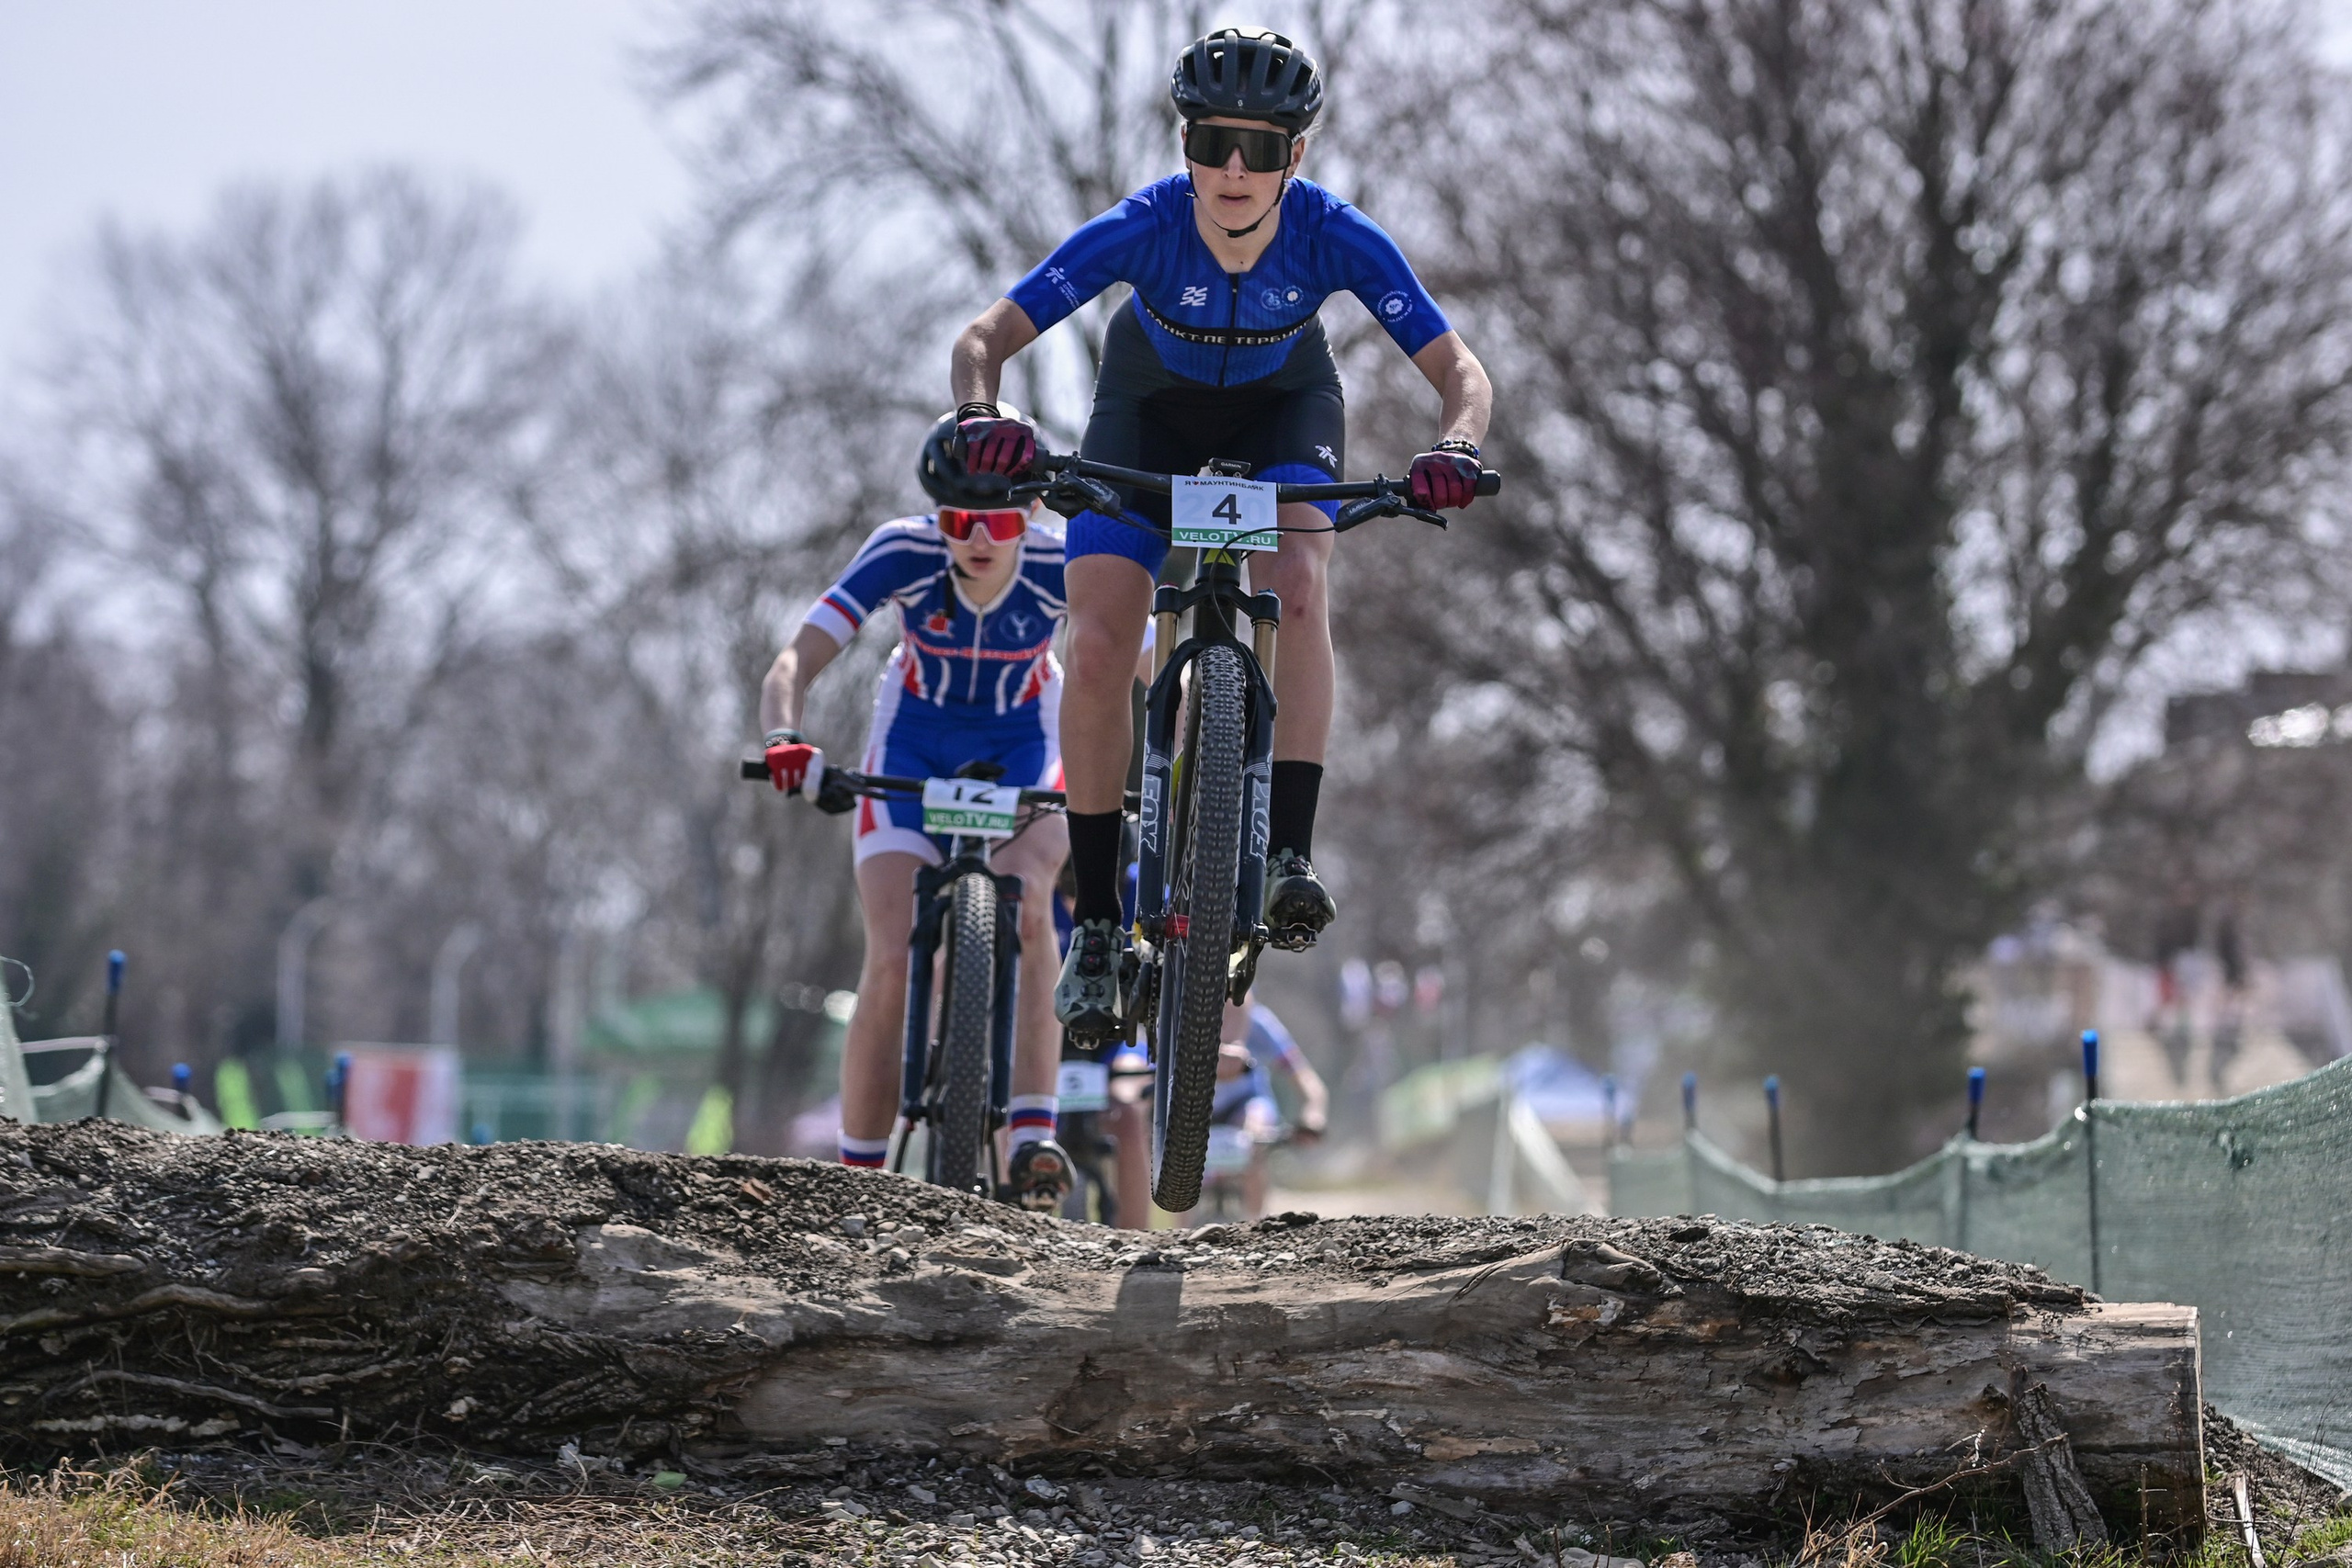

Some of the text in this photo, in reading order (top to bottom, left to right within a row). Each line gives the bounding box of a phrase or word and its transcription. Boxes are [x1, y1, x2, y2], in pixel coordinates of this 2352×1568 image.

[1200, 480, 1264, 491] МАУНТИНБАЙК
[1212, 493, 1242, 525] 4
[954, 786, 993, 805] 12
